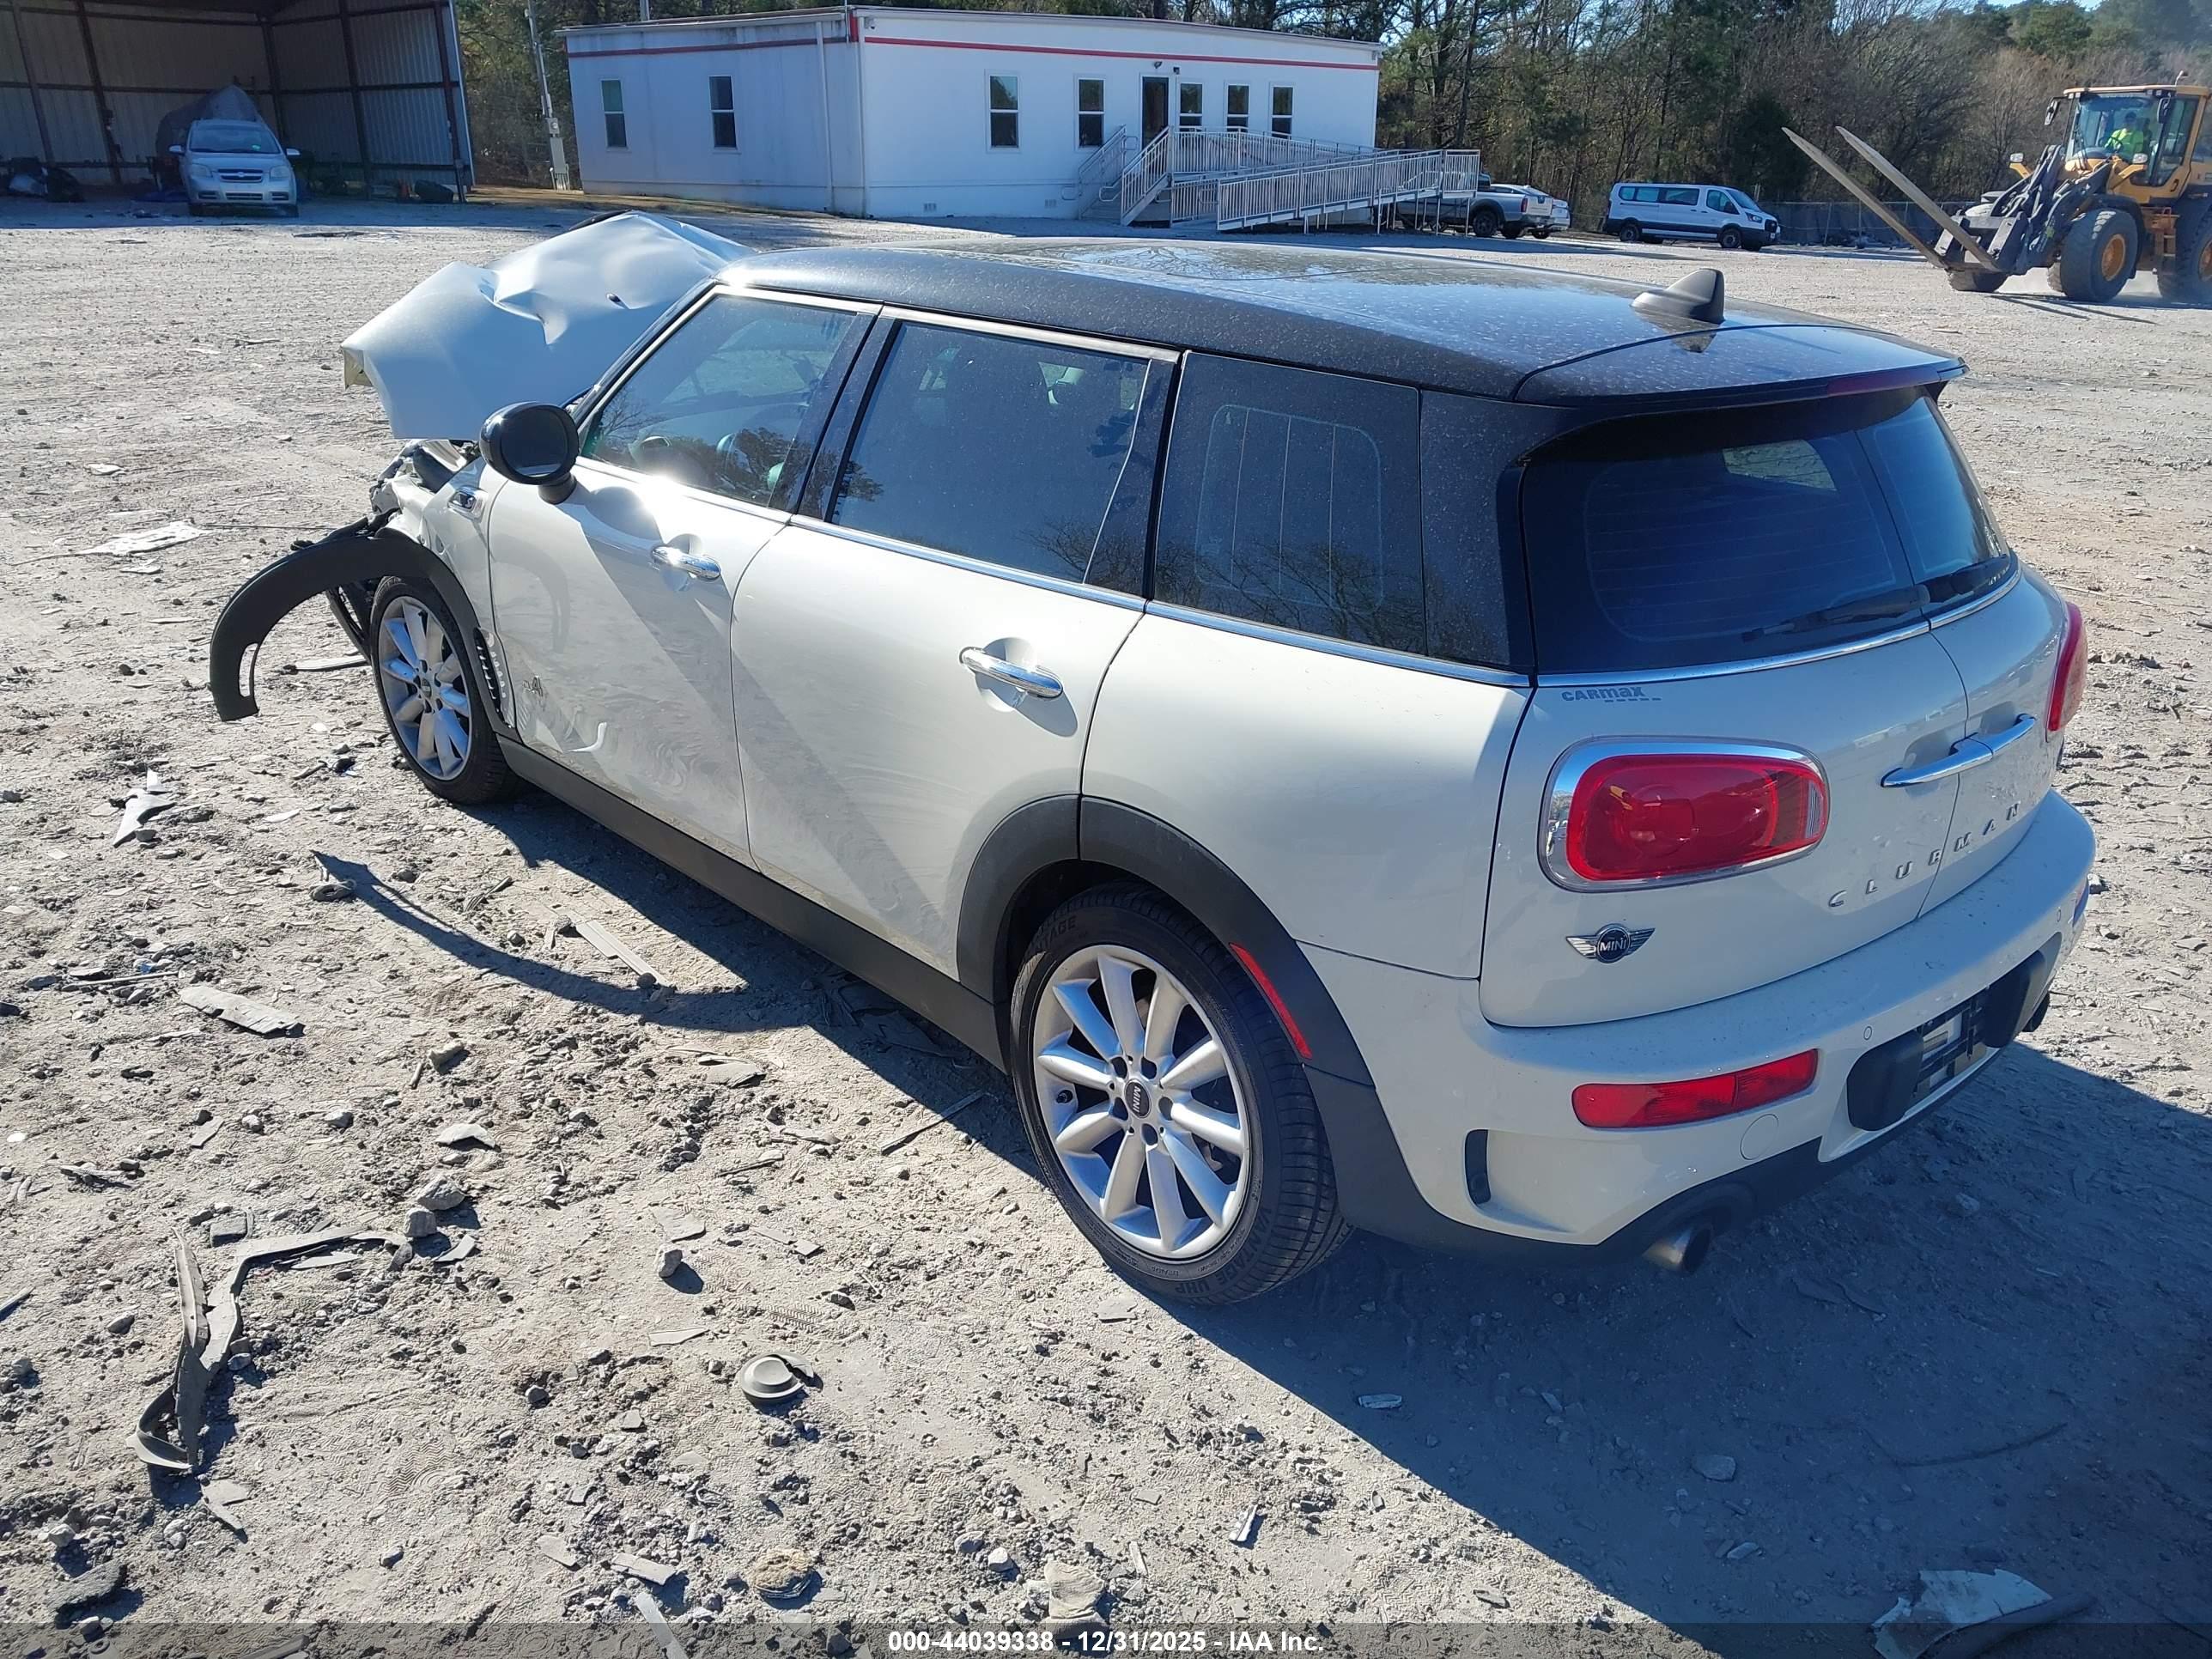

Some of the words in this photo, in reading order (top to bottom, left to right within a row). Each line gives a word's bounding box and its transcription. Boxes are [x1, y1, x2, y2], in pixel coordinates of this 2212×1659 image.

[1827, 801, 2021, 908] CLUBMAN
[1599, 938, 1627, 952] MINI
[1133, 1085, 1142, 1114] MINI
[1174, 1279, 1211, 1295] UHP
